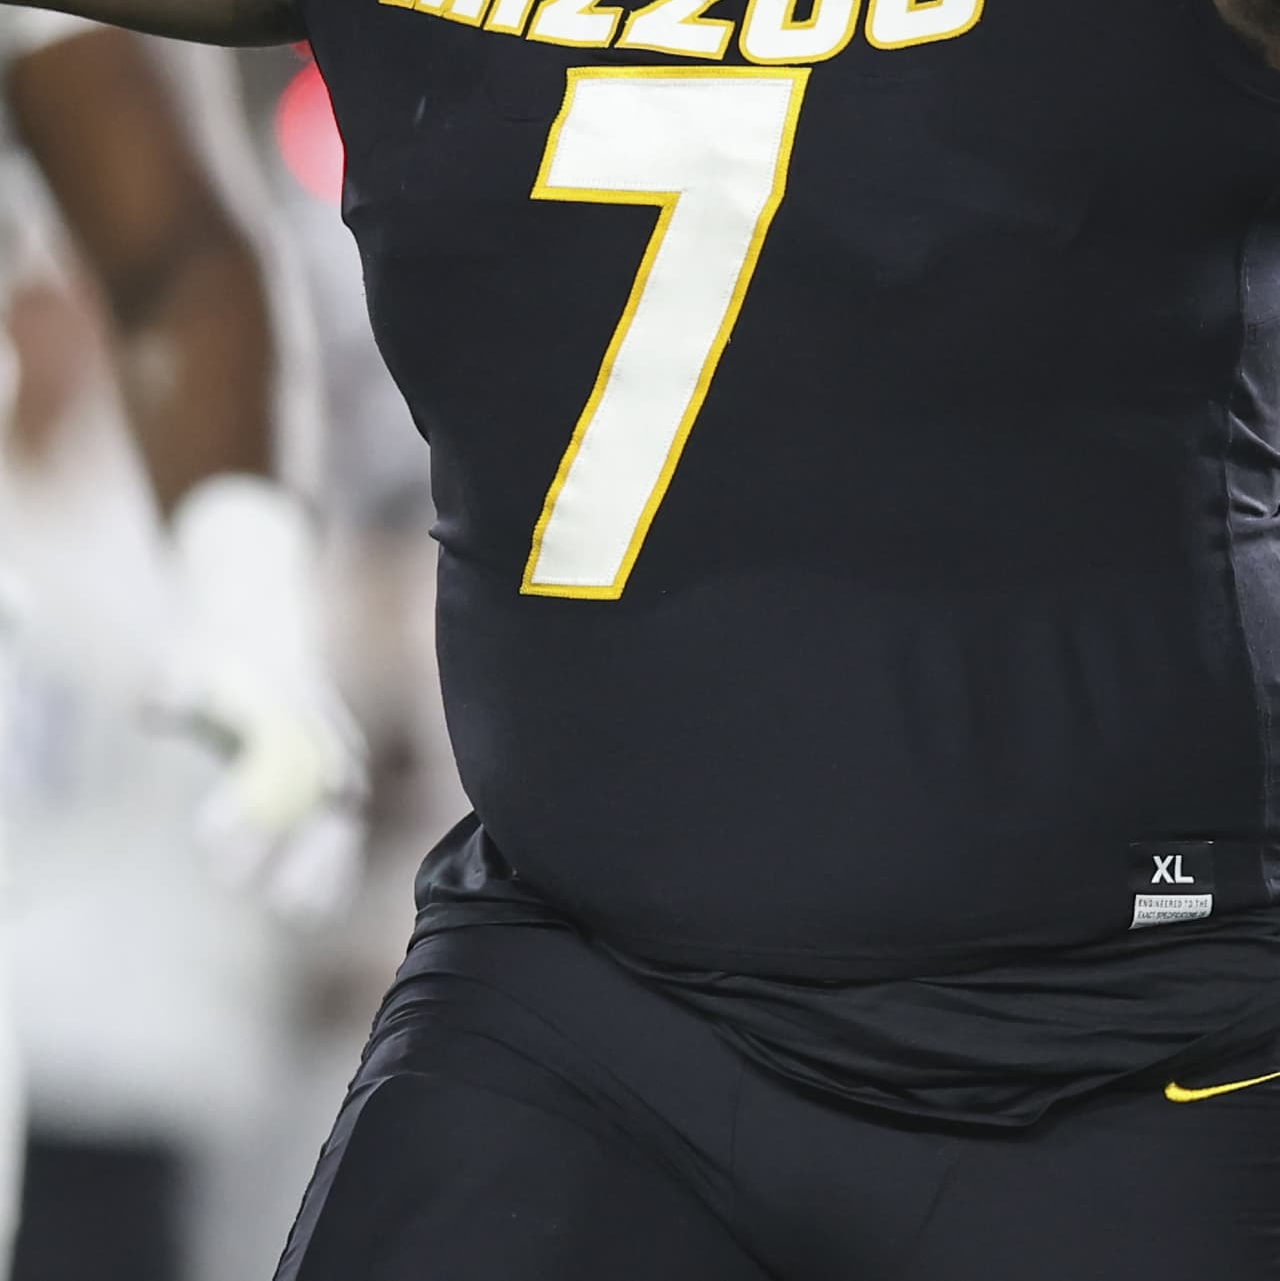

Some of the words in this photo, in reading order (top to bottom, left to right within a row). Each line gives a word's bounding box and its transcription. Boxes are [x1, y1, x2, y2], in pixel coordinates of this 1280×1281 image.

[519, 65, 812, 601] 7
[1150, 854, 1195, 884] XL
[1137, 899, 1183, 908] ENGNEERED
